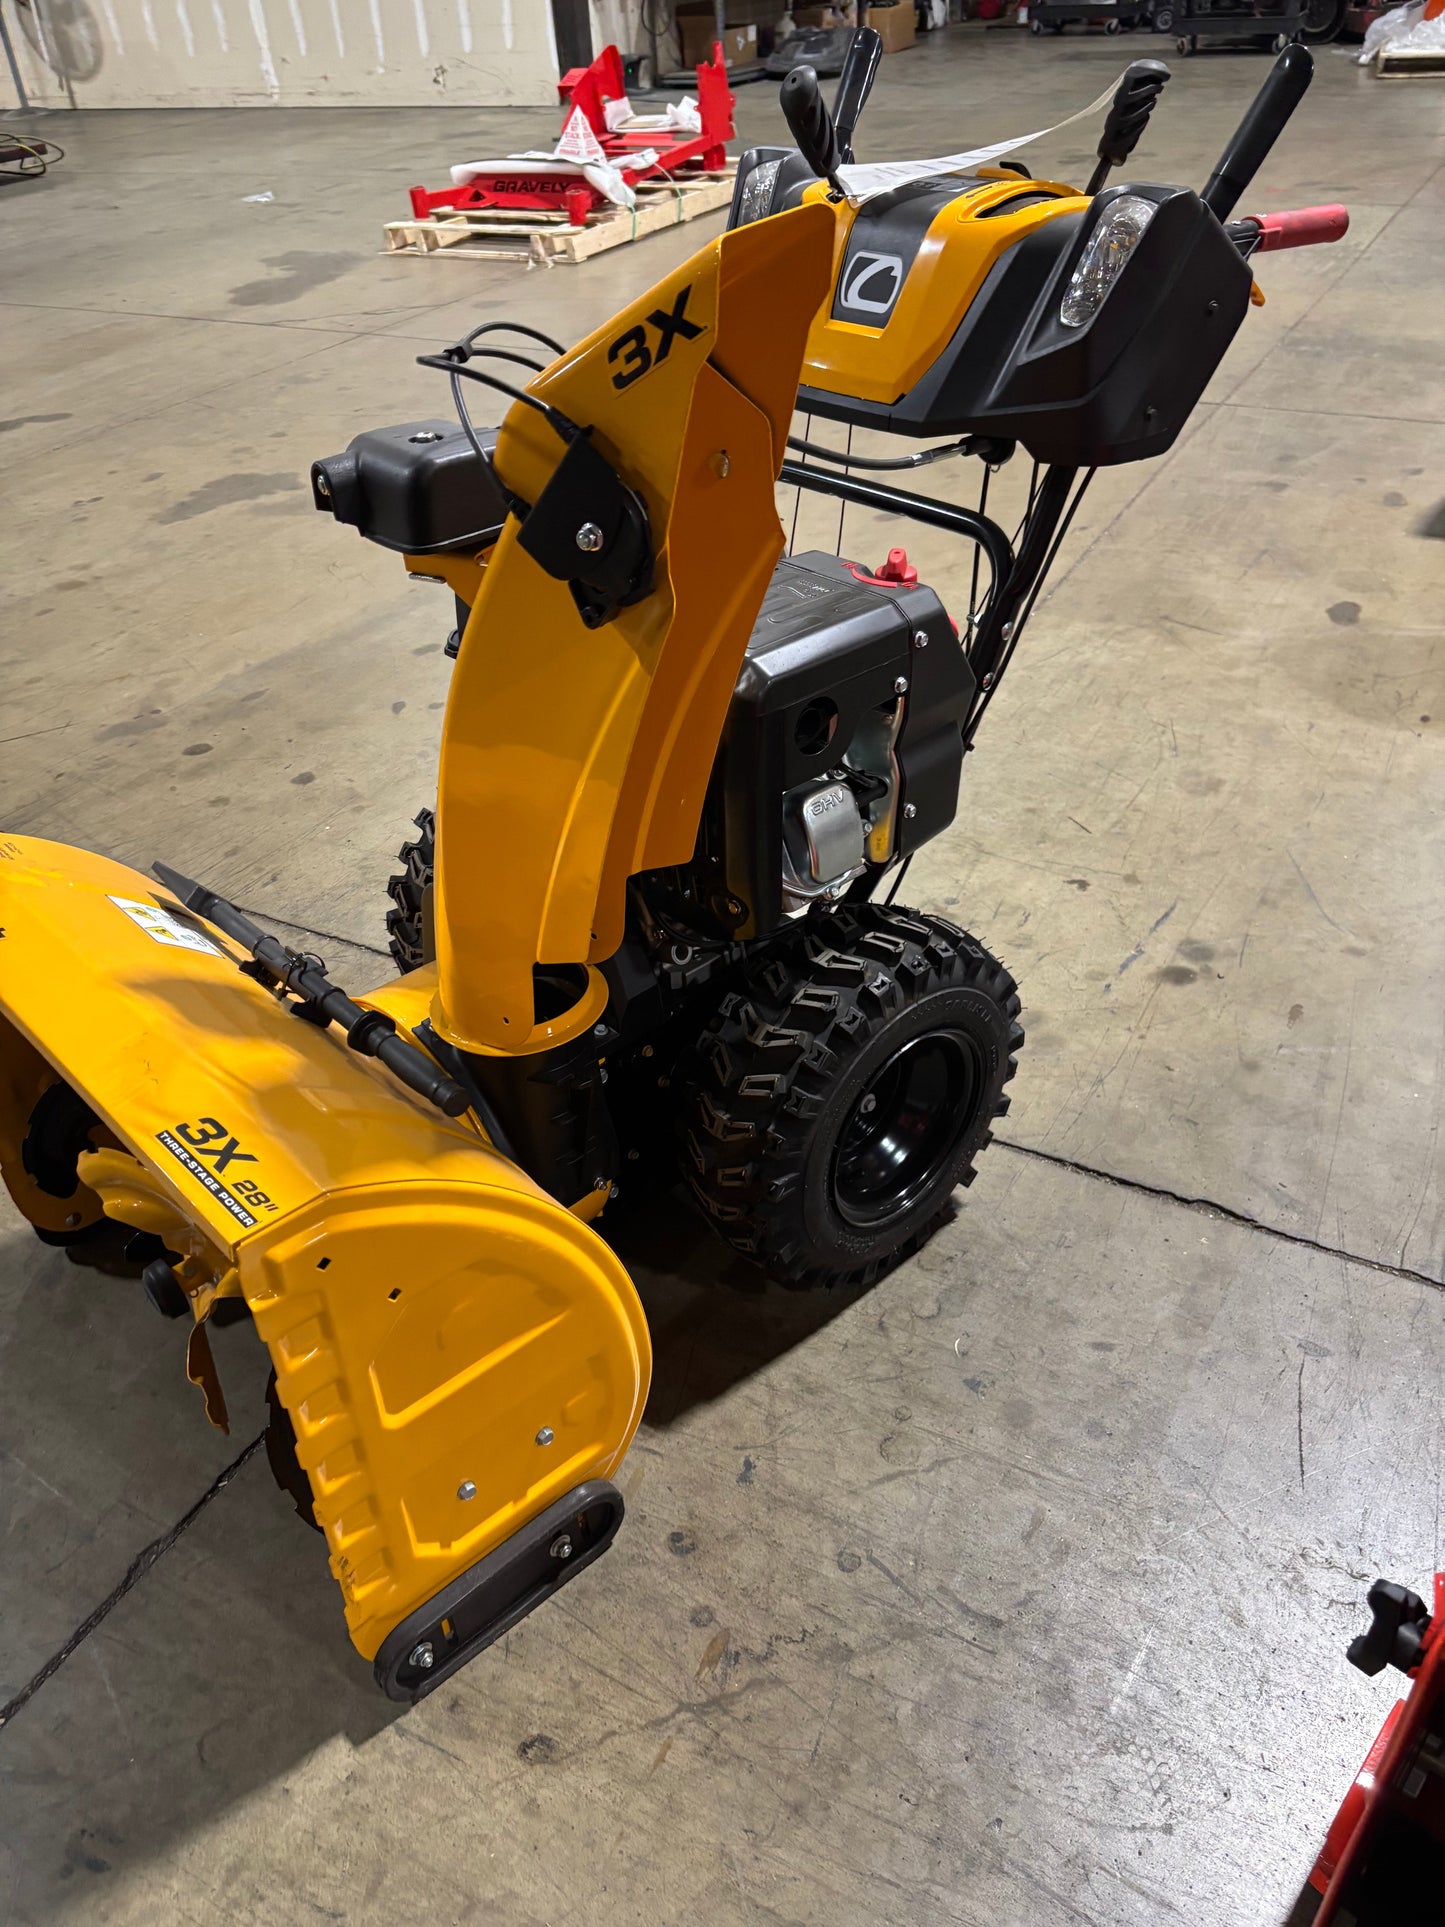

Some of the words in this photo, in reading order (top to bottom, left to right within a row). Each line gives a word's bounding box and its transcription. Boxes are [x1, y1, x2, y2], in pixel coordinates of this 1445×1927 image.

[493, 181, 570, 193] GRAVELY
[608, 283, 703, 390] 3X
[811, 788, 844, 817] OHV
[175, 1117, 259, 1174] 3X
[160, 1132, 220, 1191] THREE-STAGE
[218, 1191, 255, 1227] POWER
